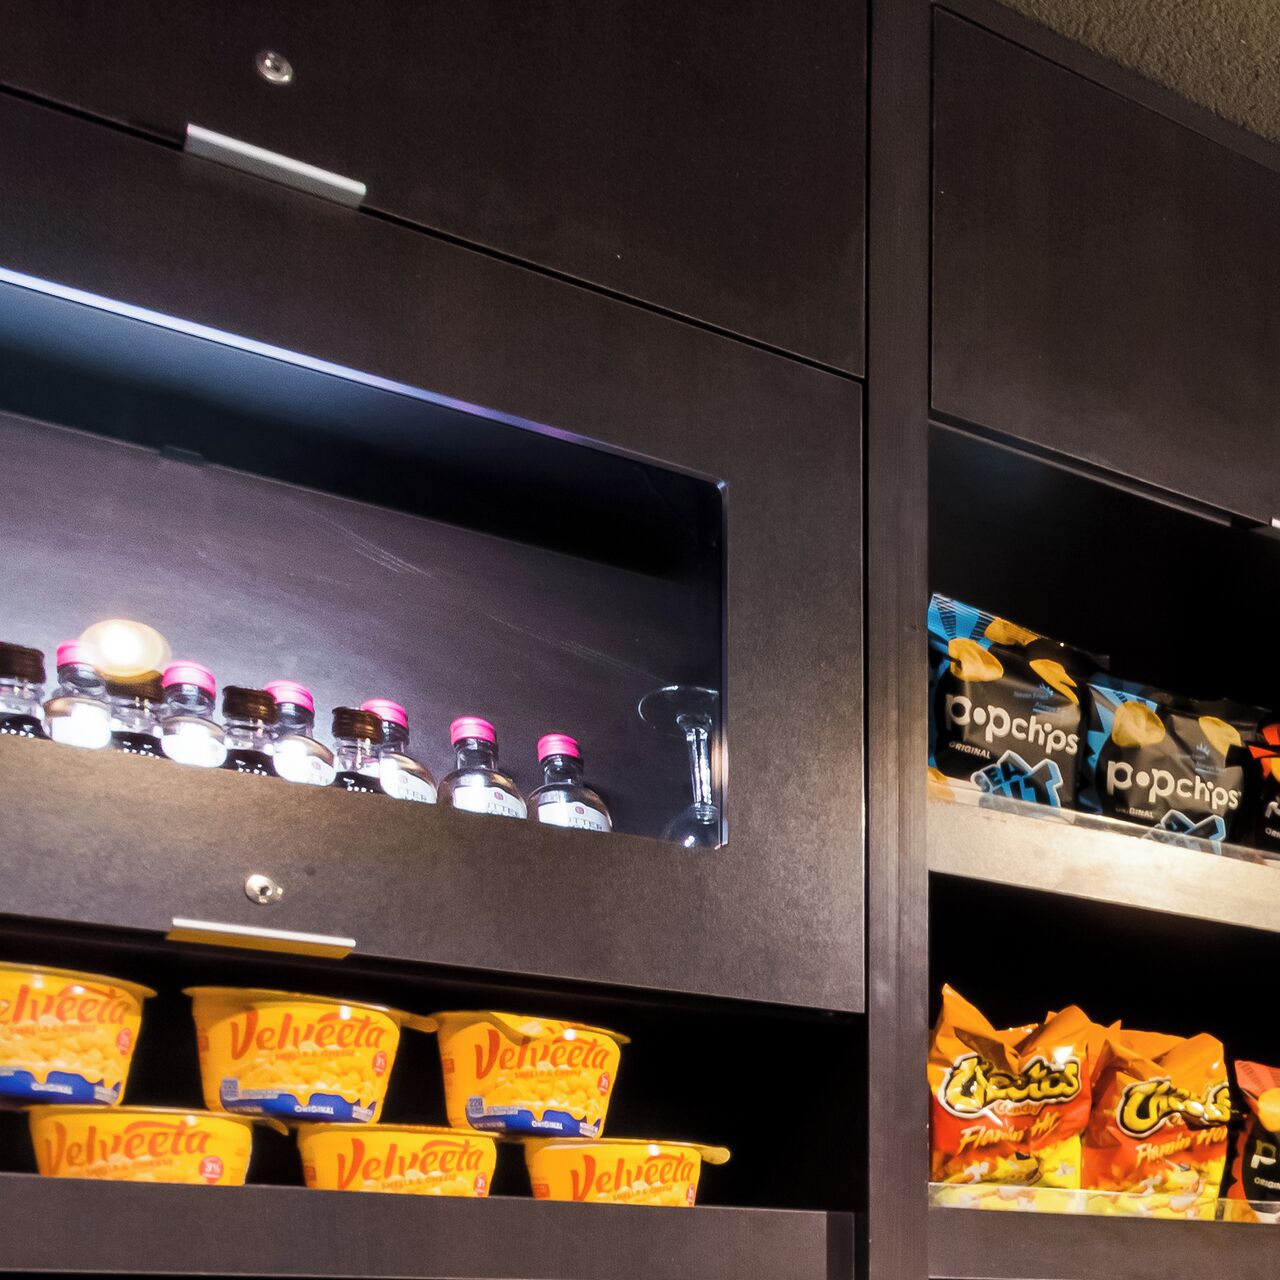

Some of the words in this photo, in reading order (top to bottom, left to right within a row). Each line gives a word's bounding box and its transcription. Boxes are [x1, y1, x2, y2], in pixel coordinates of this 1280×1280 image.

[946, 694, 1080, 755] popchips
[949, 742, 991, 759] ORIGINAL
[1107, 760, 1240, 810] popchips
[230, 1009, 387, 1060] Velveeta
[475, 1029, 610, 1080] Velveeta
[294, 1105, 334, 1115] ORIGINAL
[531, 1121, 563, 1131] ORIGINAL
[46, 1118, 211, 1176] Velveeta
[337, 1138, 483, 1190] Velveeta
[571, 1155, 695, 1201] Velveeta
